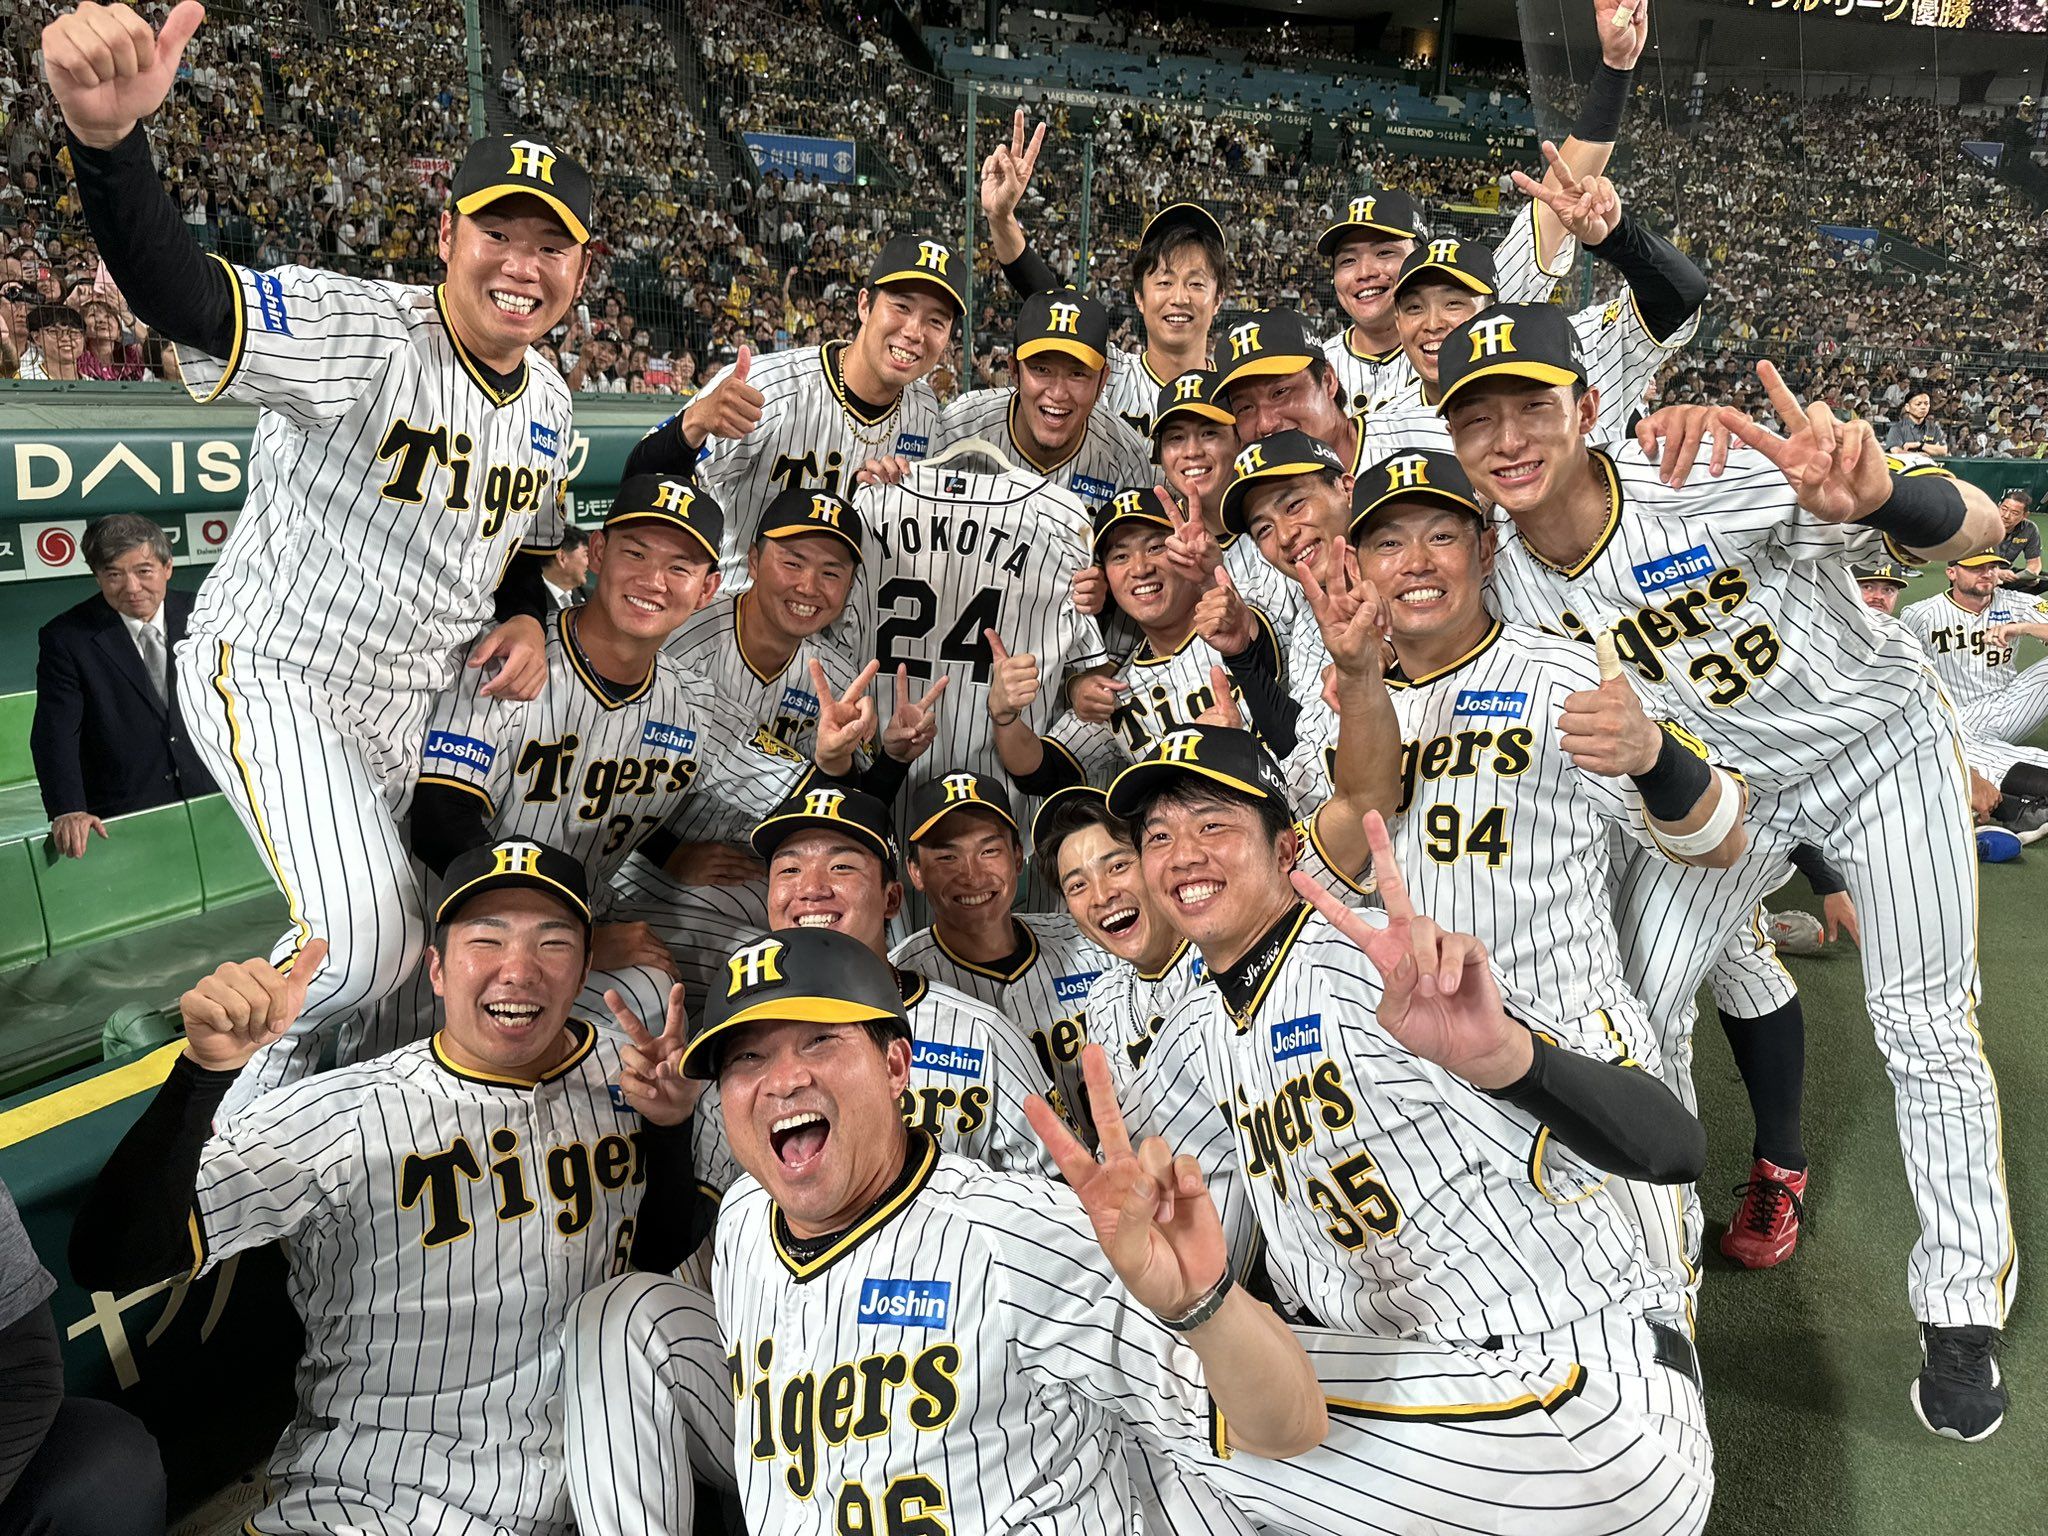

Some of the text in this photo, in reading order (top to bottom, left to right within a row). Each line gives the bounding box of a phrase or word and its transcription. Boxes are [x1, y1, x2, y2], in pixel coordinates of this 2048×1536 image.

[1065, 92, 1098, 105] BEYOND
[1242, 110, 1273, 123] BEYOND
[1385, 125, 1434, 139] MAKE BEYOND
[1072, 478, 1114, 498] Joshin
[872, 515, 1032, 580] YOKOTA
[1639, 554, 1713, 589] Joshin
[875, 577, 1006, 686] 24
[1687, 623, 1783, 708] 38
[1986, 648, 2013, 668] 98
[1455, 695, 1524, 714] Joshin
[428, 736, 491, 768] Joshin
[643, 726, 694, 750] Joshin
[515, 732, 699, 822] Tigers
[602, 814, 663, 856] 37
[1424, 802, 1512, 868] 94
[1272, 1023, 1320, 1055] Joshin
[912, 1047, 981, 1073] Joshin
[1306, 1150, 1402, 1252] 35
[860, 1288, 946, 1320] Joshin
